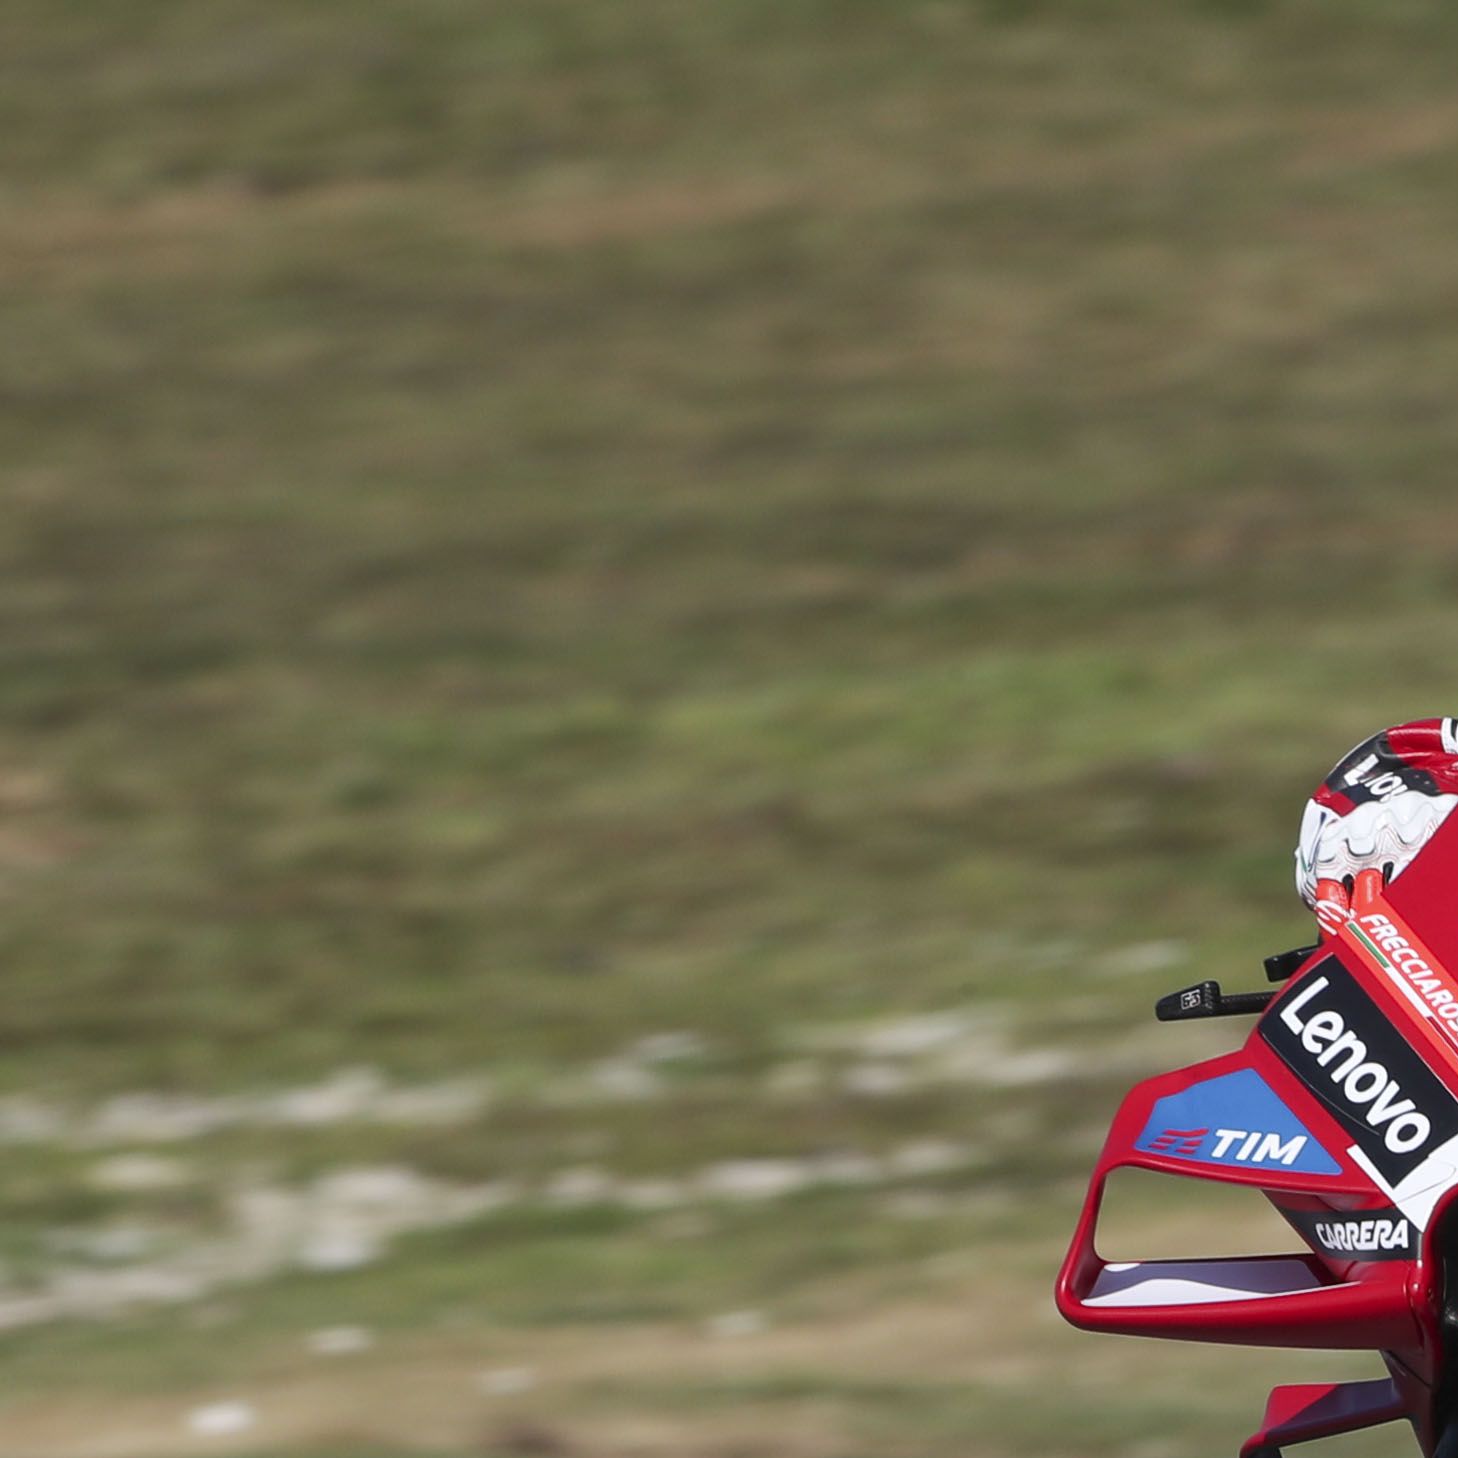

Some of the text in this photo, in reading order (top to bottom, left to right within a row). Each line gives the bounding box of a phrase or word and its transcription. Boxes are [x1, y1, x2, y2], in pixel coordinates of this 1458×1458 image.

[1279, 975, 1433, 1156] Lenovo
[1209, 1127, 1308, 1166] TIM
[1314, 1219, 1410, 1251] CARRERA
